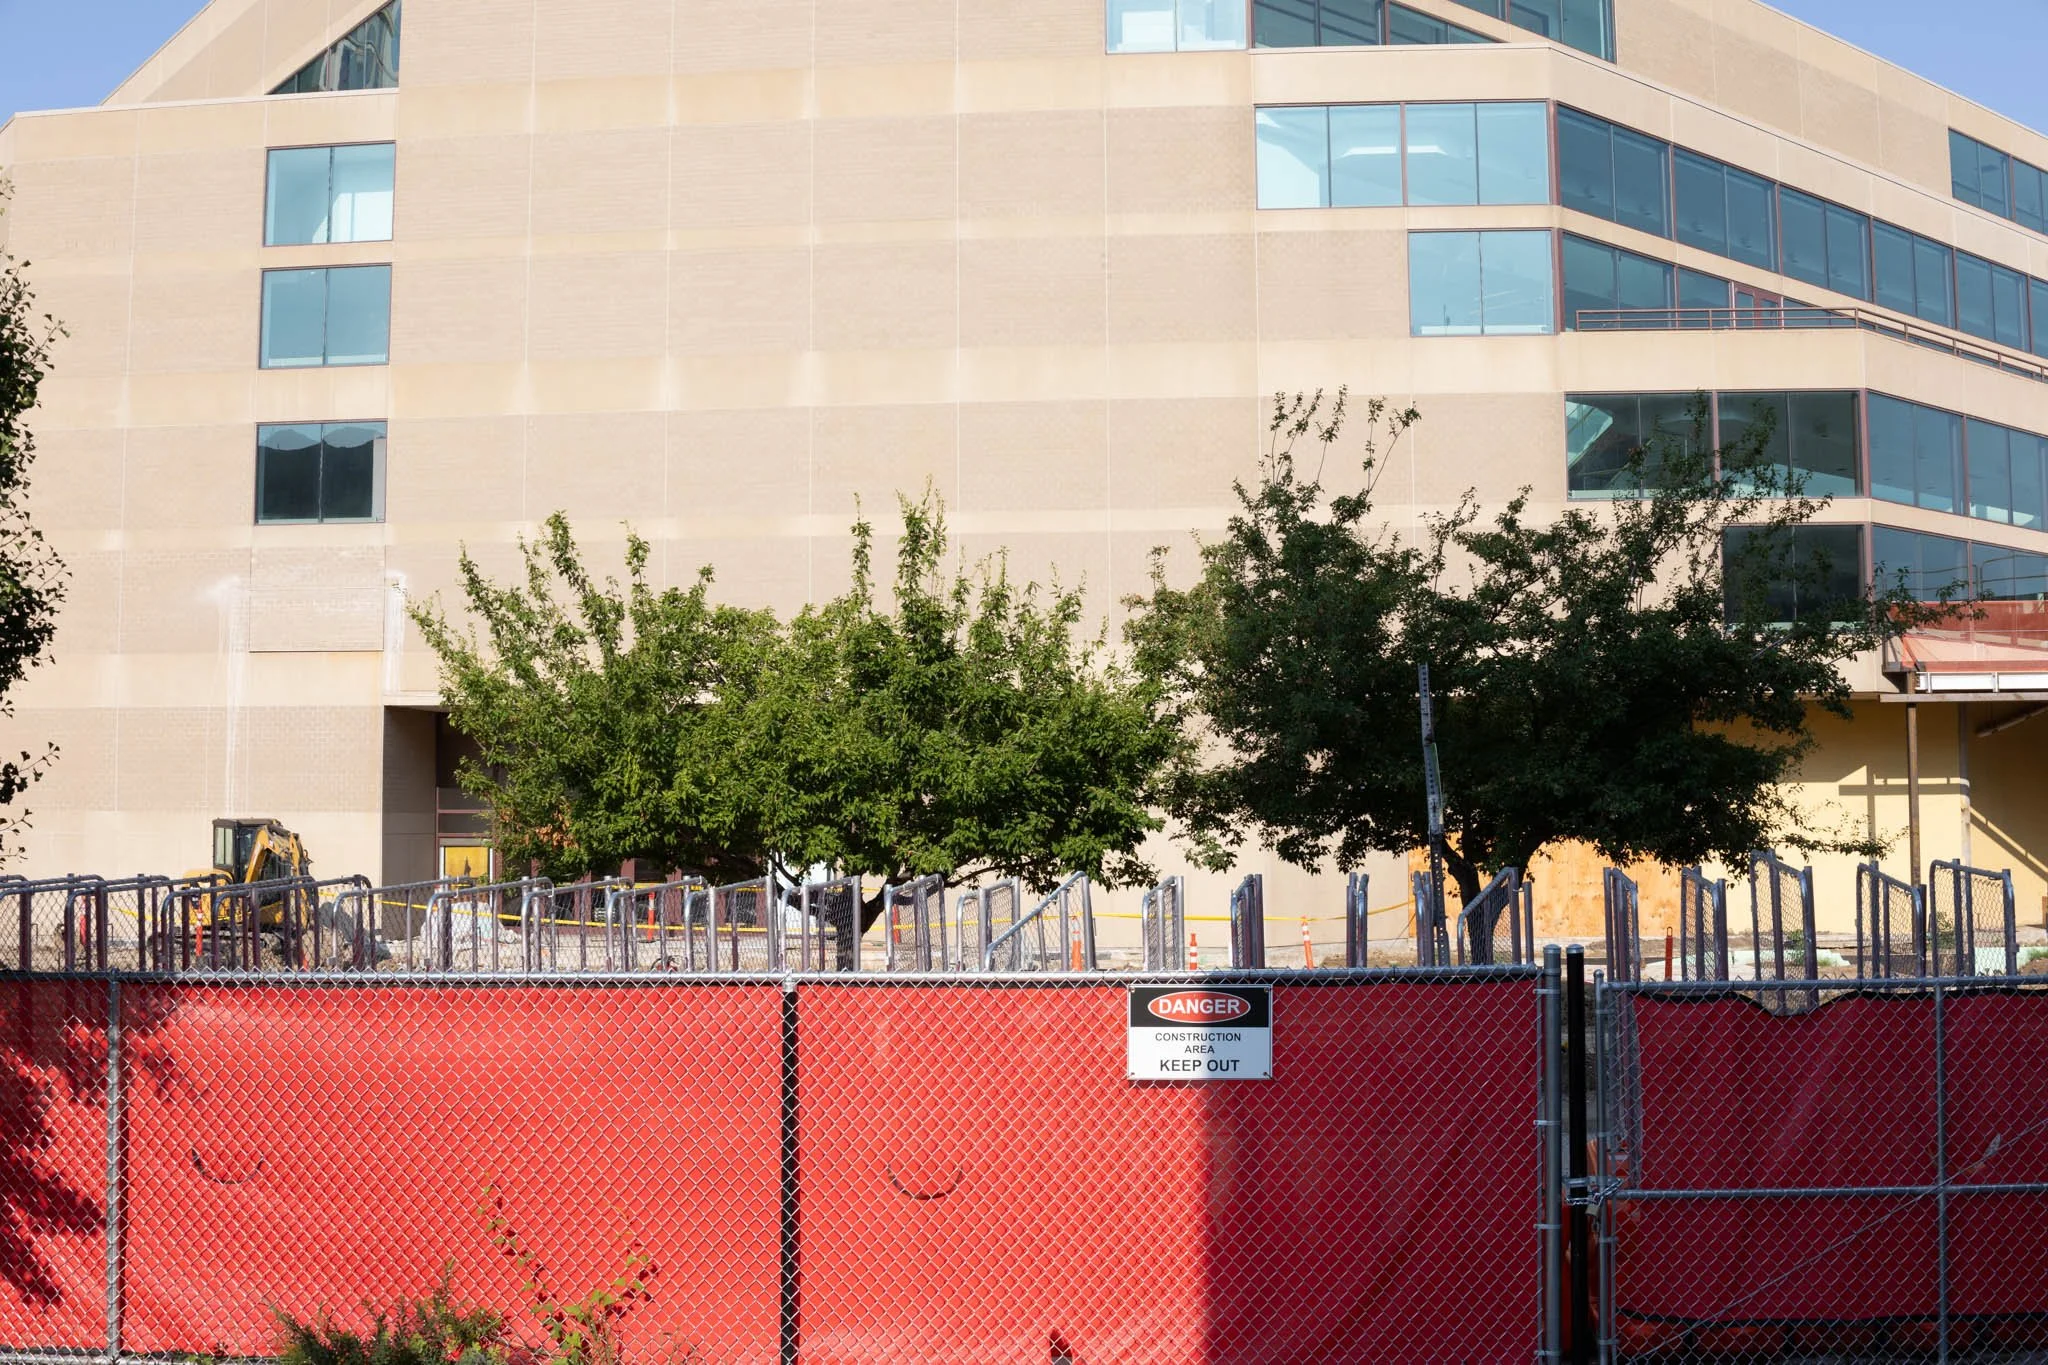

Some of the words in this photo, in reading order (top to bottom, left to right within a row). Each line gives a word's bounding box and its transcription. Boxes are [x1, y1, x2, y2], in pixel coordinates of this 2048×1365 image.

[1158, 998, 1241, 1014] DANGER
[1155, 1032, 1241, 1042] CONSTRUCTION
[1184, 1045, 1215, 1054] AREA
[1160, 1059, 1202, 1072] KEEP
[1206, 1059, 1240, 1072] OUT
